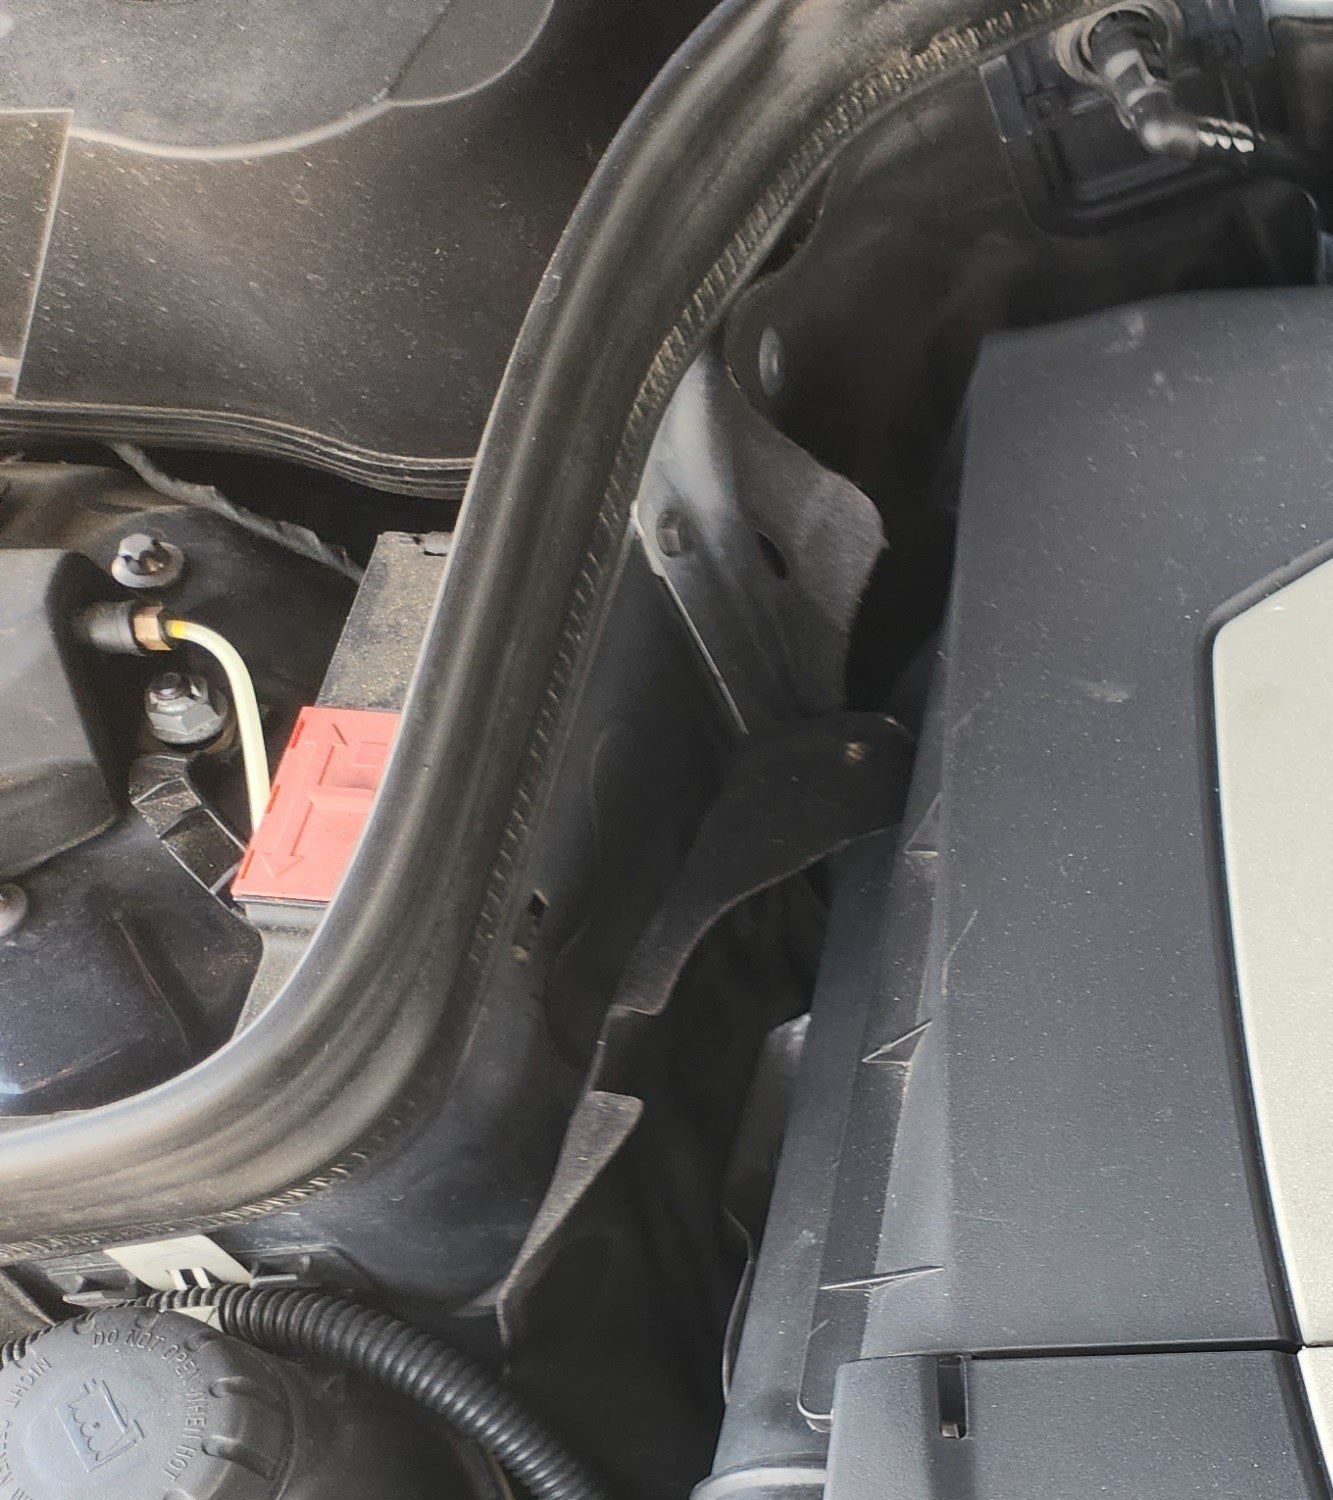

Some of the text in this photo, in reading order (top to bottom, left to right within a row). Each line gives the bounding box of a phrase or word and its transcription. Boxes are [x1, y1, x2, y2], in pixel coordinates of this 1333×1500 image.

[92, 1329, 119, 1348] DO
[125, 1329, 166, 1351] NOT
[161, 1344, 200, 1384] OPEN
[4, 1357, 52, 1409] NICHT
[163, 1444, 198, 1481] HOT
